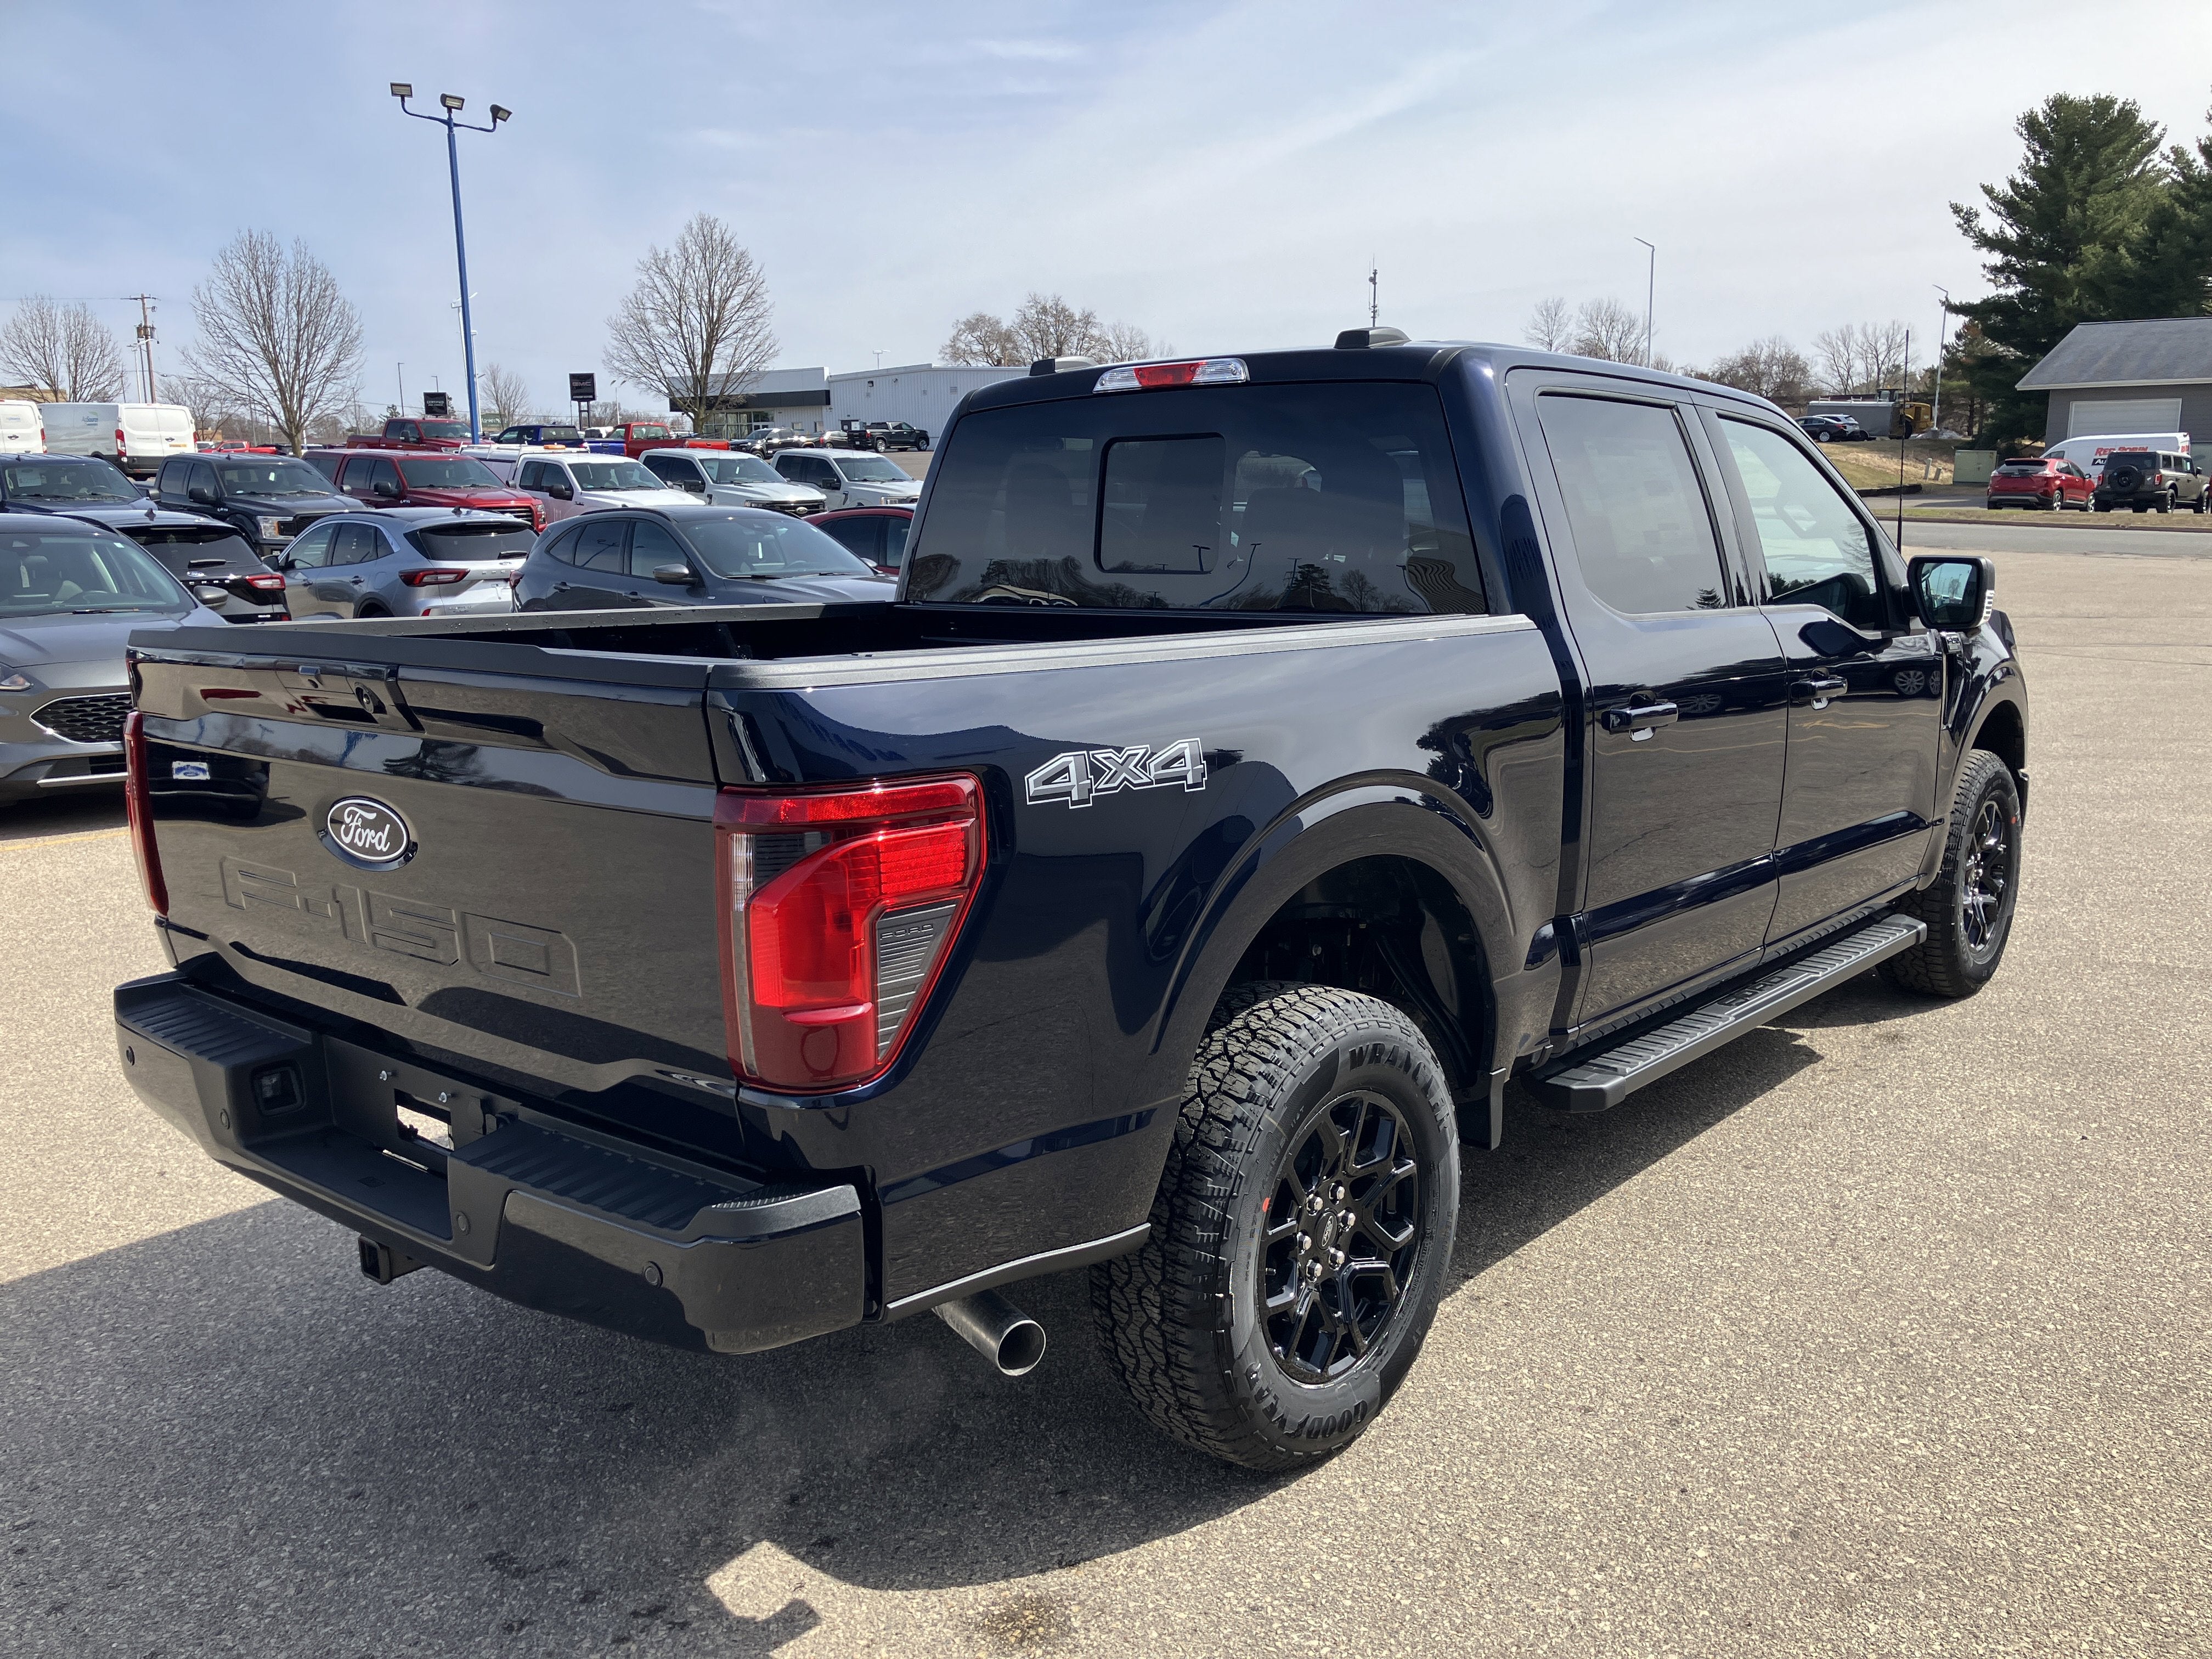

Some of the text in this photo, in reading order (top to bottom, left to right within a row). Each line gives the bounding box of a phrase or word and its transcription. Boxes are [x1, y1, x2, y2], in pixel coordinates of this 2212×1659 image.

[340, 806, 391, 852] Ford
[219, 855, 582, 998] F-150
[879, 924, 934, 941] FORD
[1348, 1042, 1450, 1133] WRANGLER
[1244, 1363, 1368, 1440] GOODYEAR
